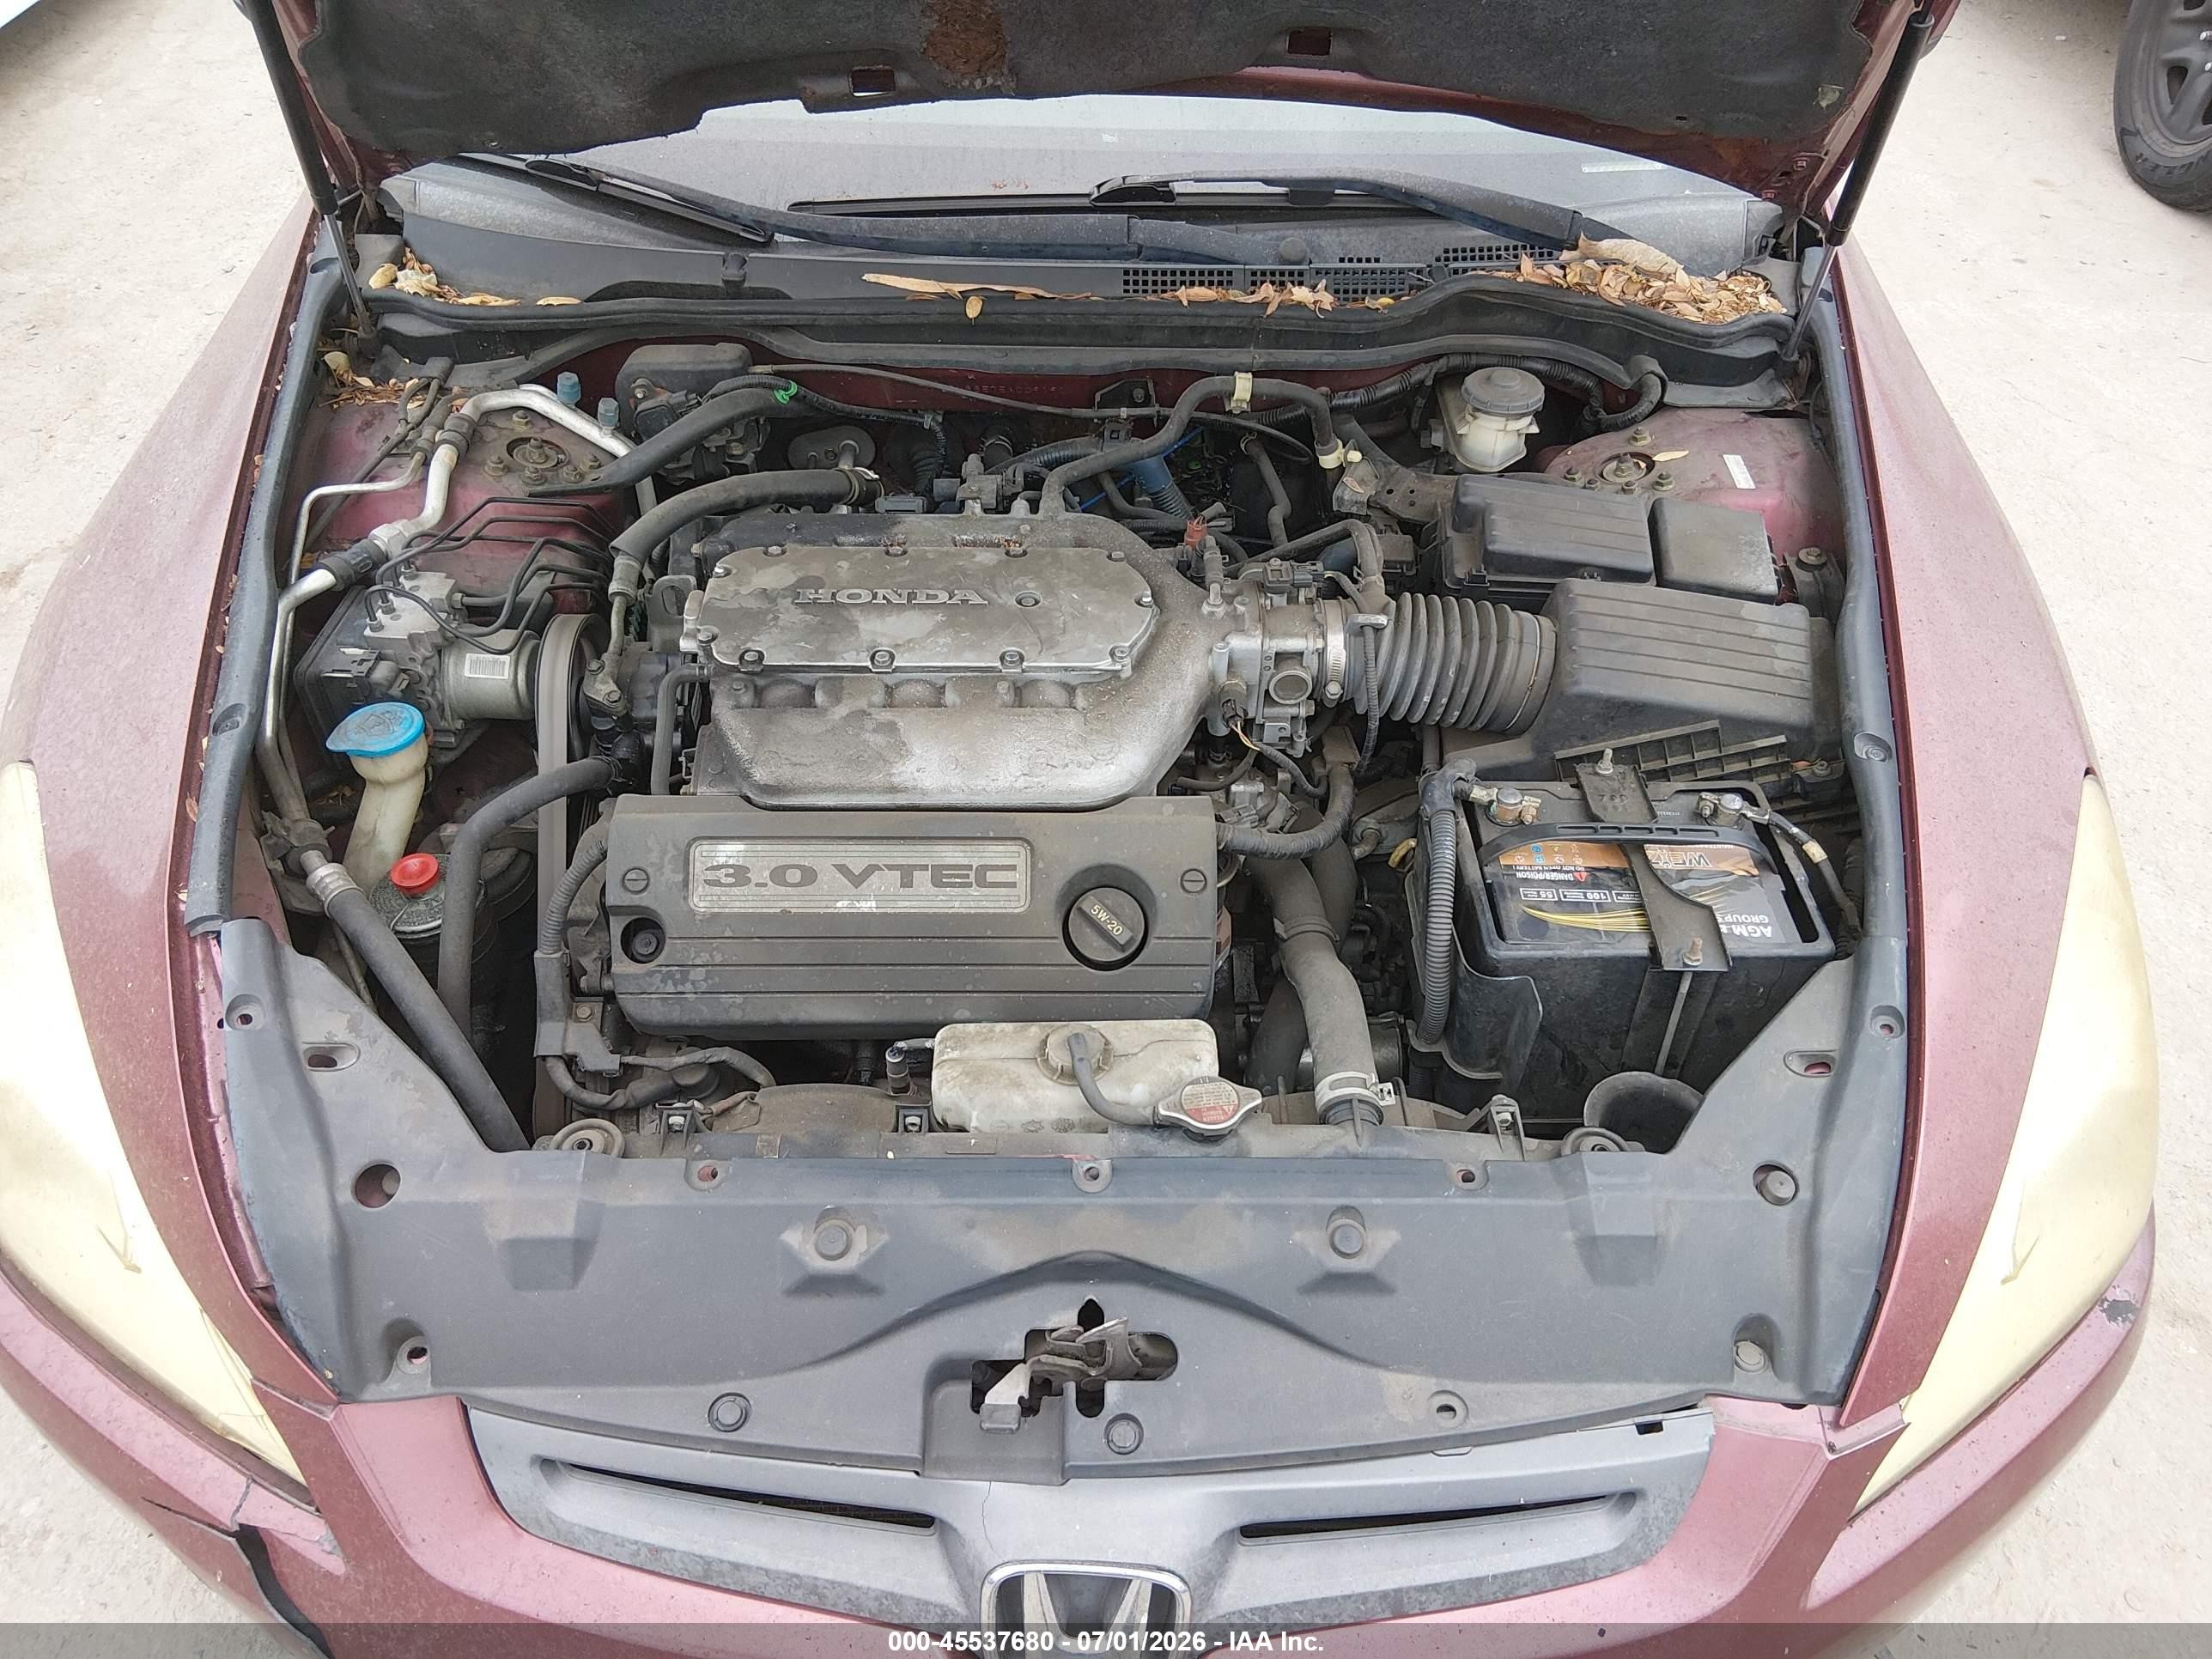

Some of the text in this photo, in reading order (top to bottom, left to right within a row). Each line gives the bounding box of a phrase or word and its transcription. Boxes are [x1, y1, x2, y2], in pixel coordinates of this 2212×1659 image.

[794, 588, 988, 605] HONDA
[702, 863, 1018, 890] 3.0 VTEC
[1516, 871, 1574, 881] DANGER/POISON
[1091, 904, 1123, 935] 5W-20
[1724, 914, 1769, 923] GROUP
[1731, 924, 1772, 938] AGM
